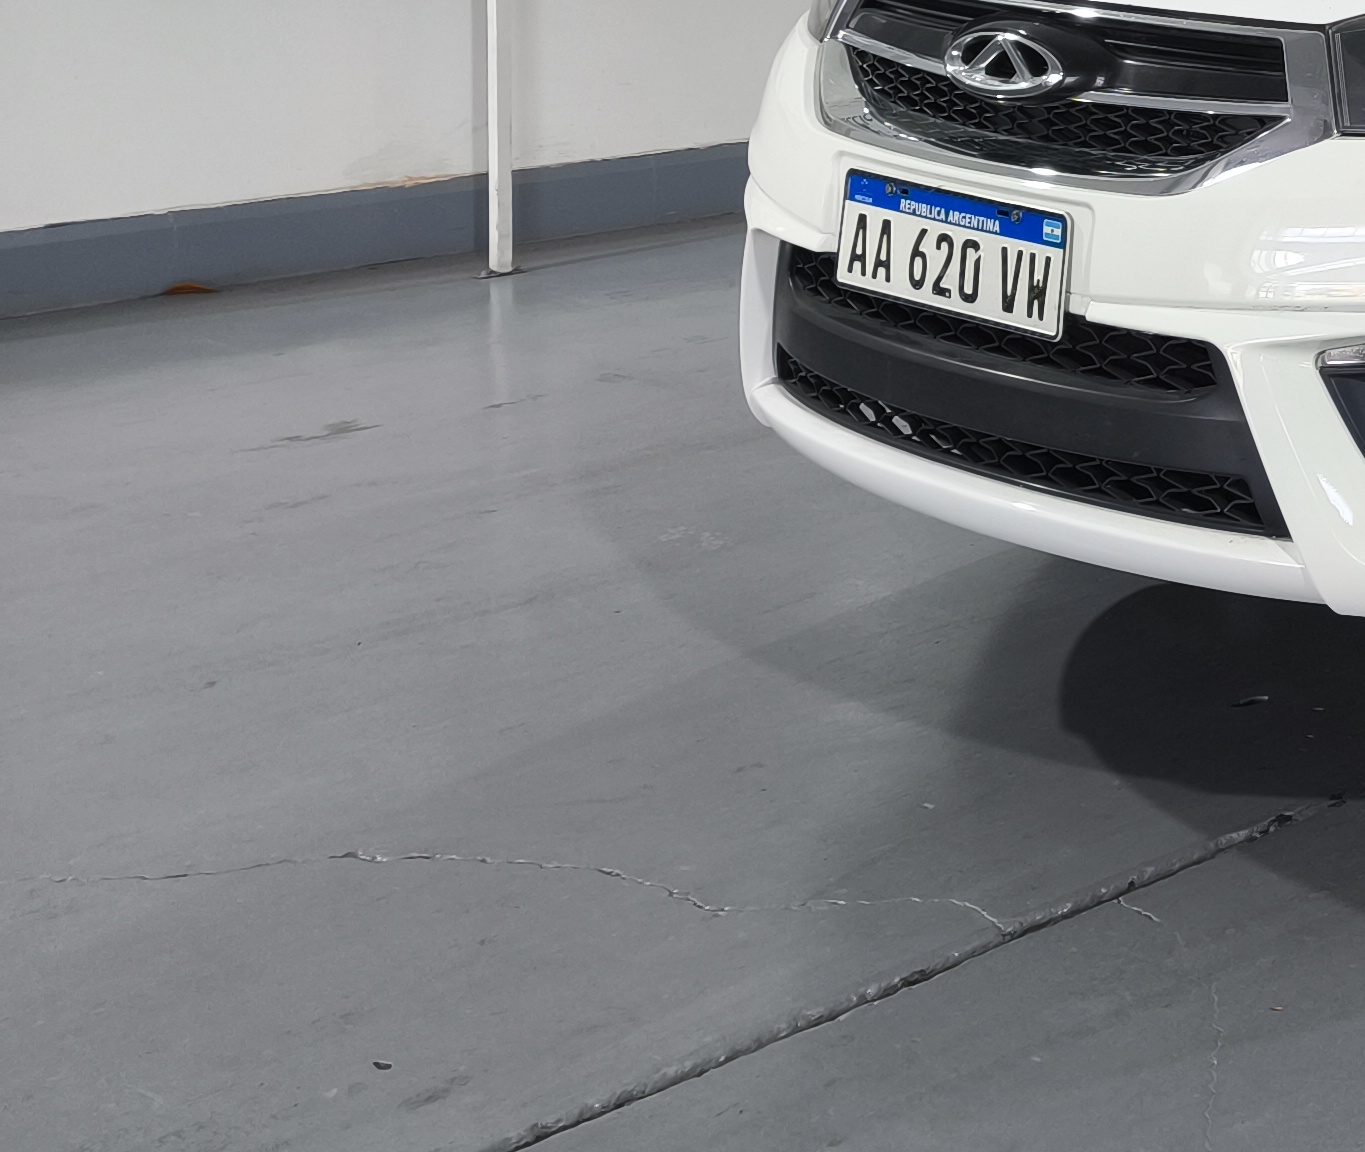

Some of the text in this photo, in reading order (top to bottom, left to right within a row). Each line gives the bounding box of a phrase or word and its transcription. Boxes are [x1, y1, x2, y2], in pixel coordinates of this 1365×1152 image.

[900, 199, 1000, 233] REPUBLICA ARGENTINA
[847, 213, 1052, 321] AA 620 VW
